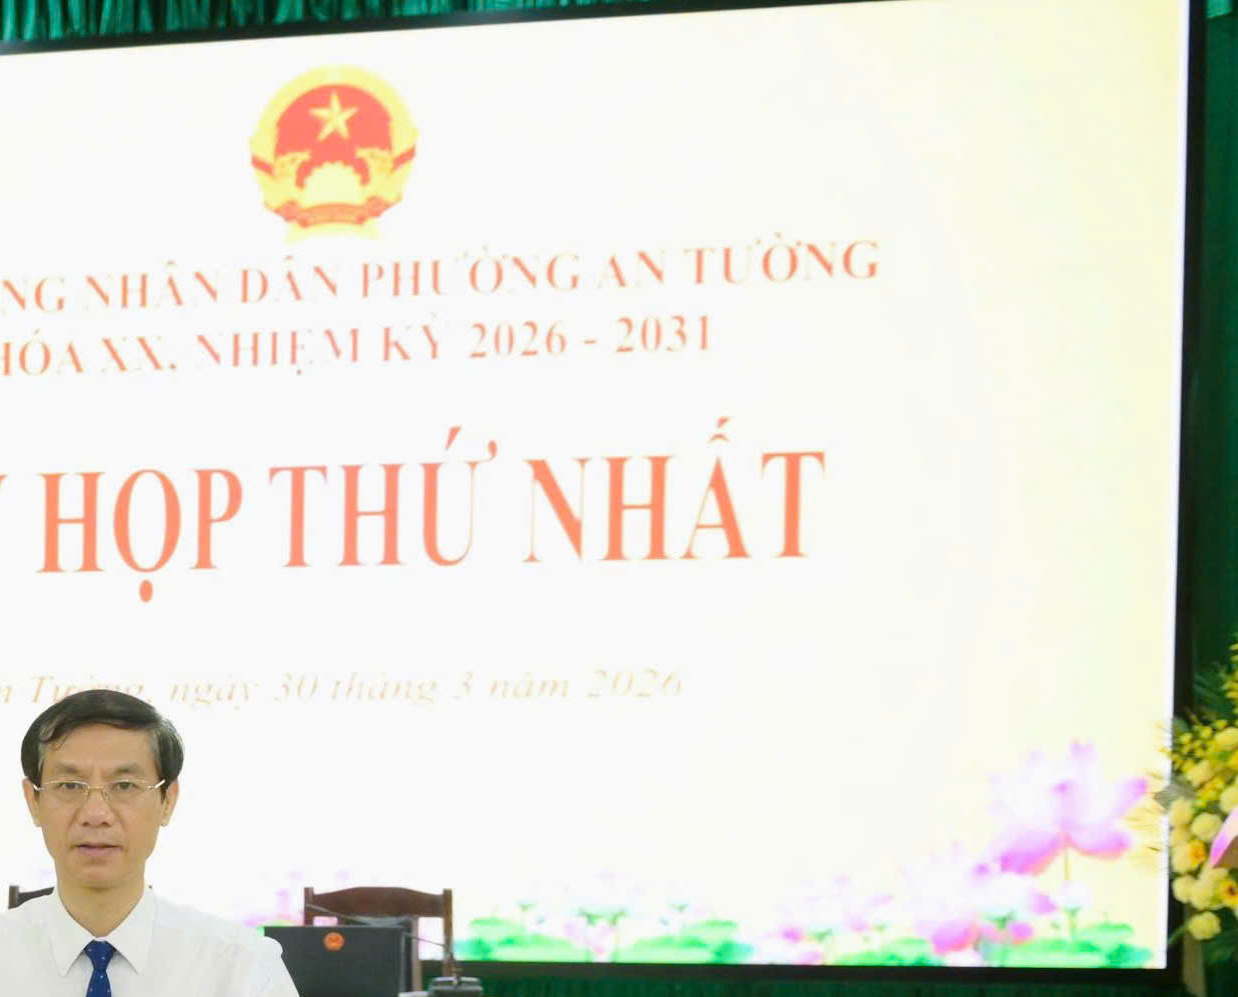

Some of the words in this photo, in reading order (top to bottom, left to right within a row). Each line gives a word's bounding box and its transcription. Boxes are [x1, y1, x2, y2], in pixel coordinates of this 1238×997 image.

[85, 260, 223, 311] NHÂN
[239, 255, 340, 305] DÂN
[361, 244, 581, 299] PHƯỜNG
[595, 250, 665, 290] AN
[683, 232, 880, 286] TƯỜNG
[196, 325, 360, 377] NHIỆM
[381, 313, 446, 362] KỲ
[468, 319, 569, 359] 2026
[615, 313, 711, 355] 2031
[37, 467, 244, 602] HỌP
[268, 425, 499, 568] THỨ
[522, 416, 827, 564] NHẤT
[273, 671, 318, 703] 30
[329, 671, 437, 708] tháng
[452, 670, 474, 700] 3
[489, 671, 571, 700] năm
[585, 666, 685, 700] 2026
